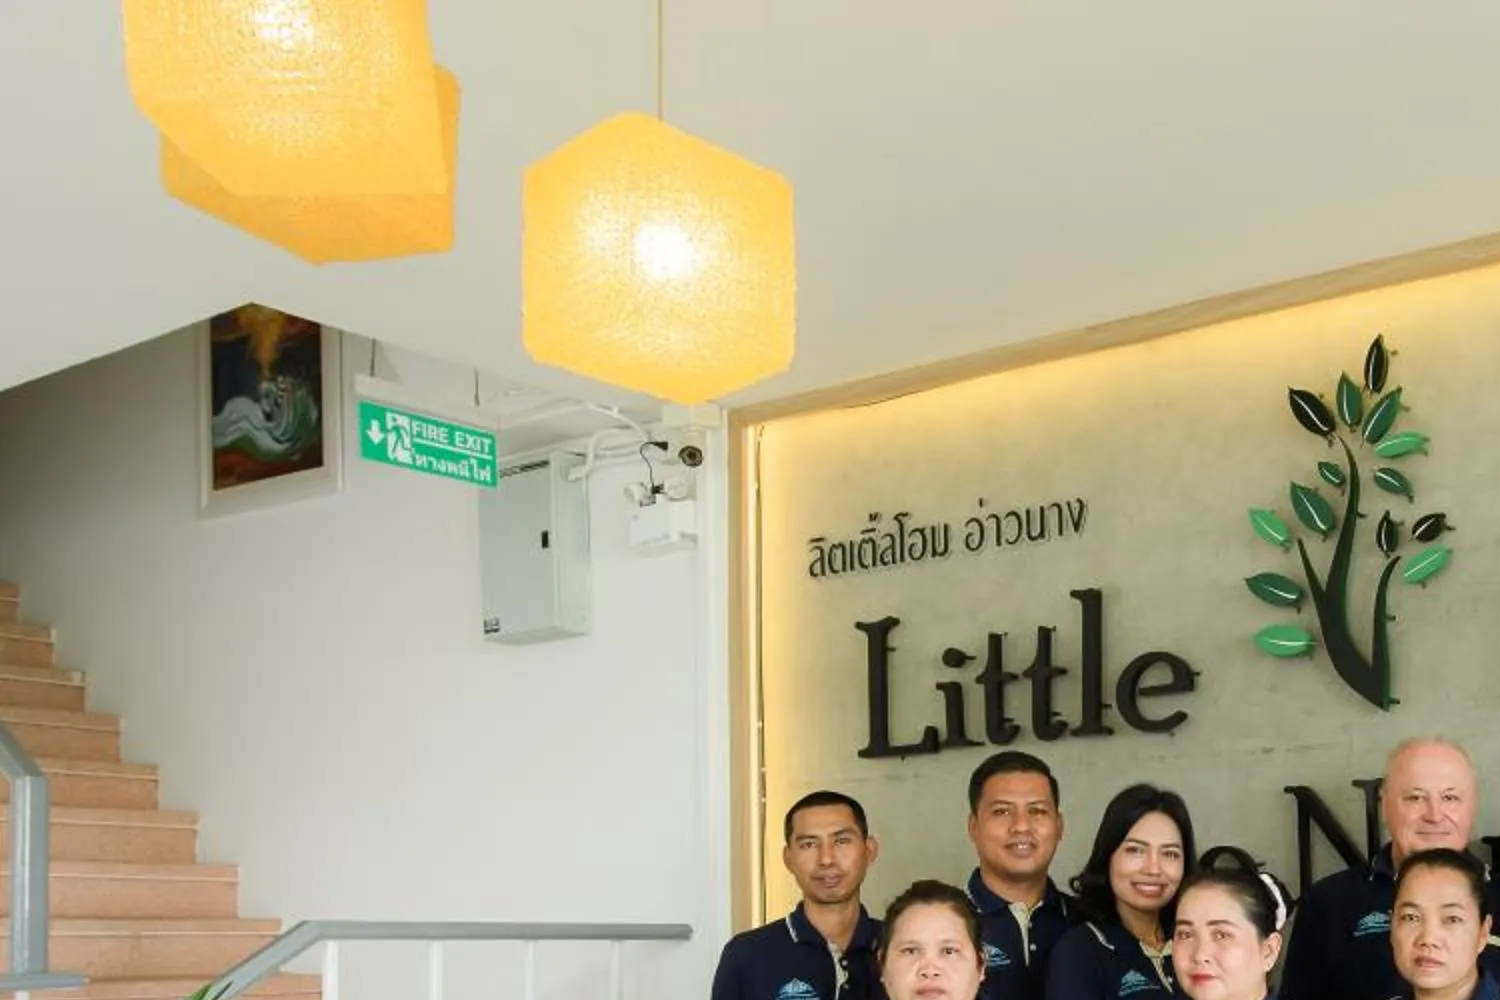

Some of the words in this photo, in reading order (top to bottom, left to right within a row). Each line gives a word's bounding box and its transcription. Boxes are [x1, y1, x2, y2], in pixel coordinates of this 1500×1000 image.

[412, 421, 449, 443] FIRE
[454, 431, 492, 453] EXIT
[414, 453, 491, 482] ทางหนีไฟ
[964, 498, 1085, 552] อ่าวนาง
[855, 587, 1199, 759] Little
